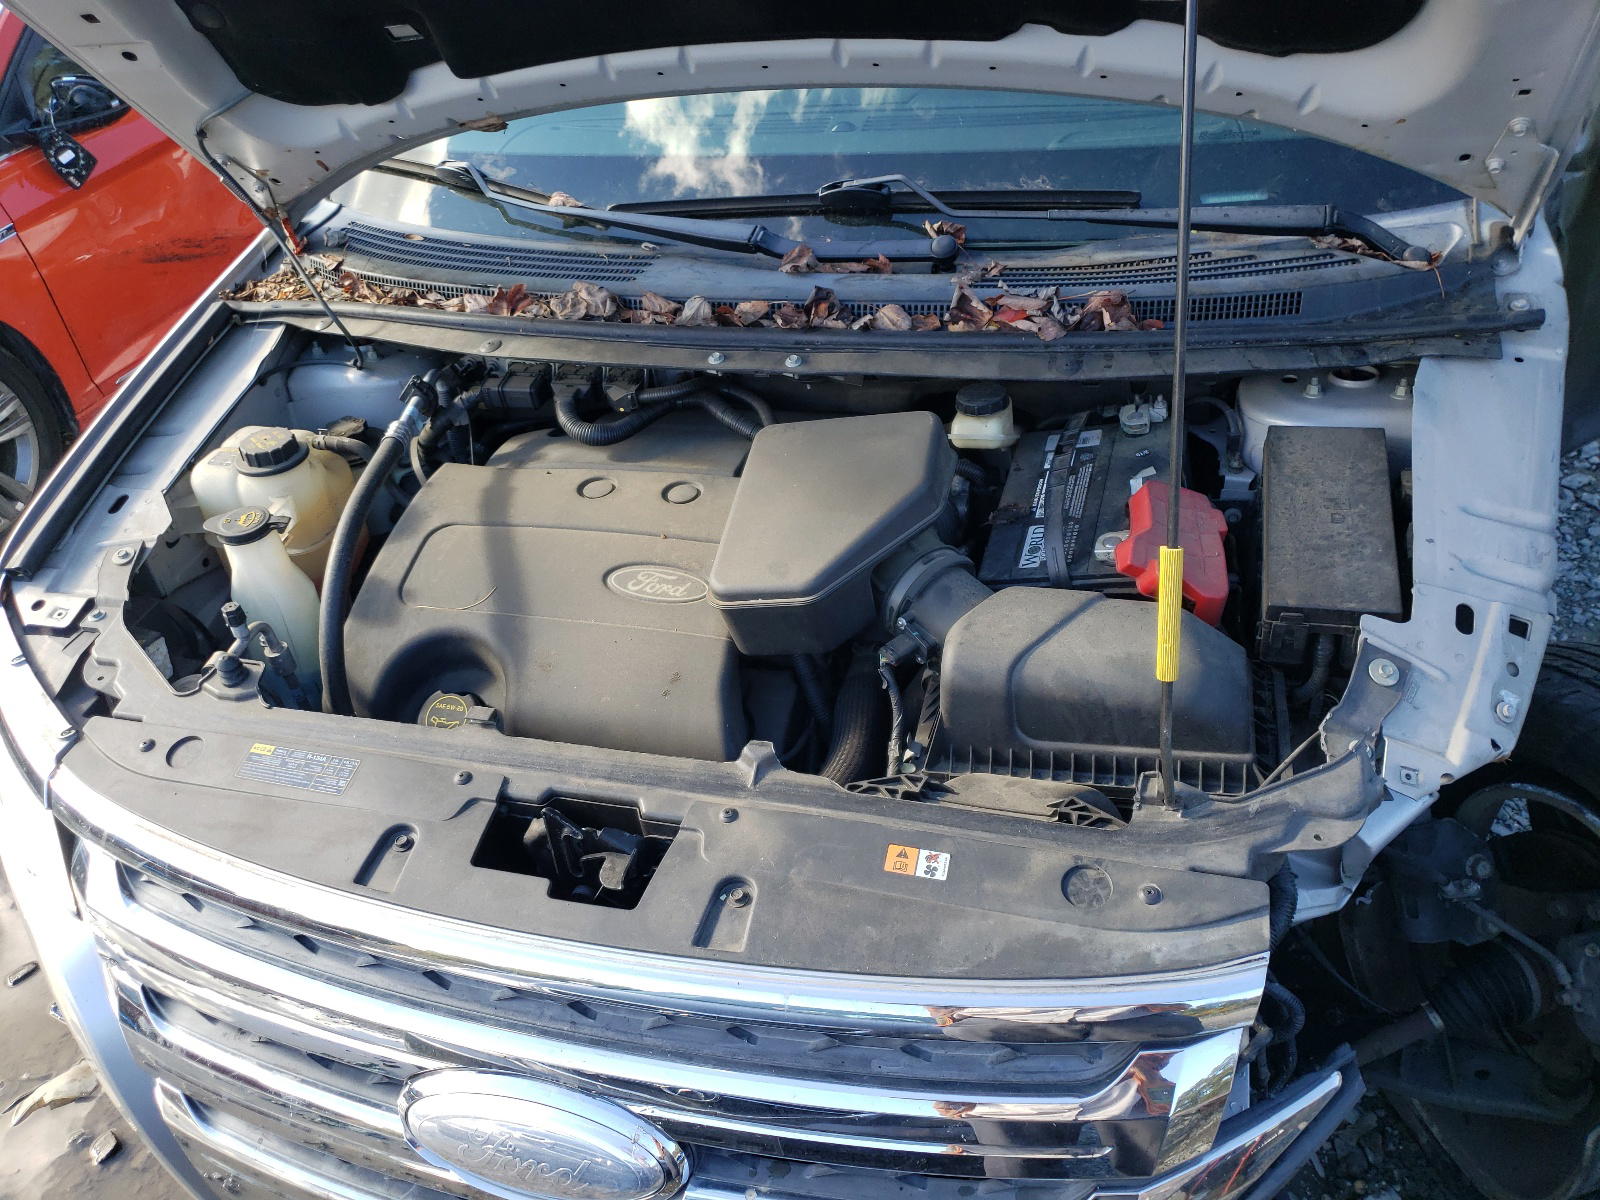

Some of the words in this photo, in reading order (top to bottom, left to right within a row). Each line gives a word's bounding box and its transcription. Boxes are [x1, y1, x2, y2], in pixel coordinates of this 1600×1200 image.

[1022, 526, 1044, 567] WORLD
[627, 570, 692, 597] Ford
[457, 1128, 592, 1191] Ford
